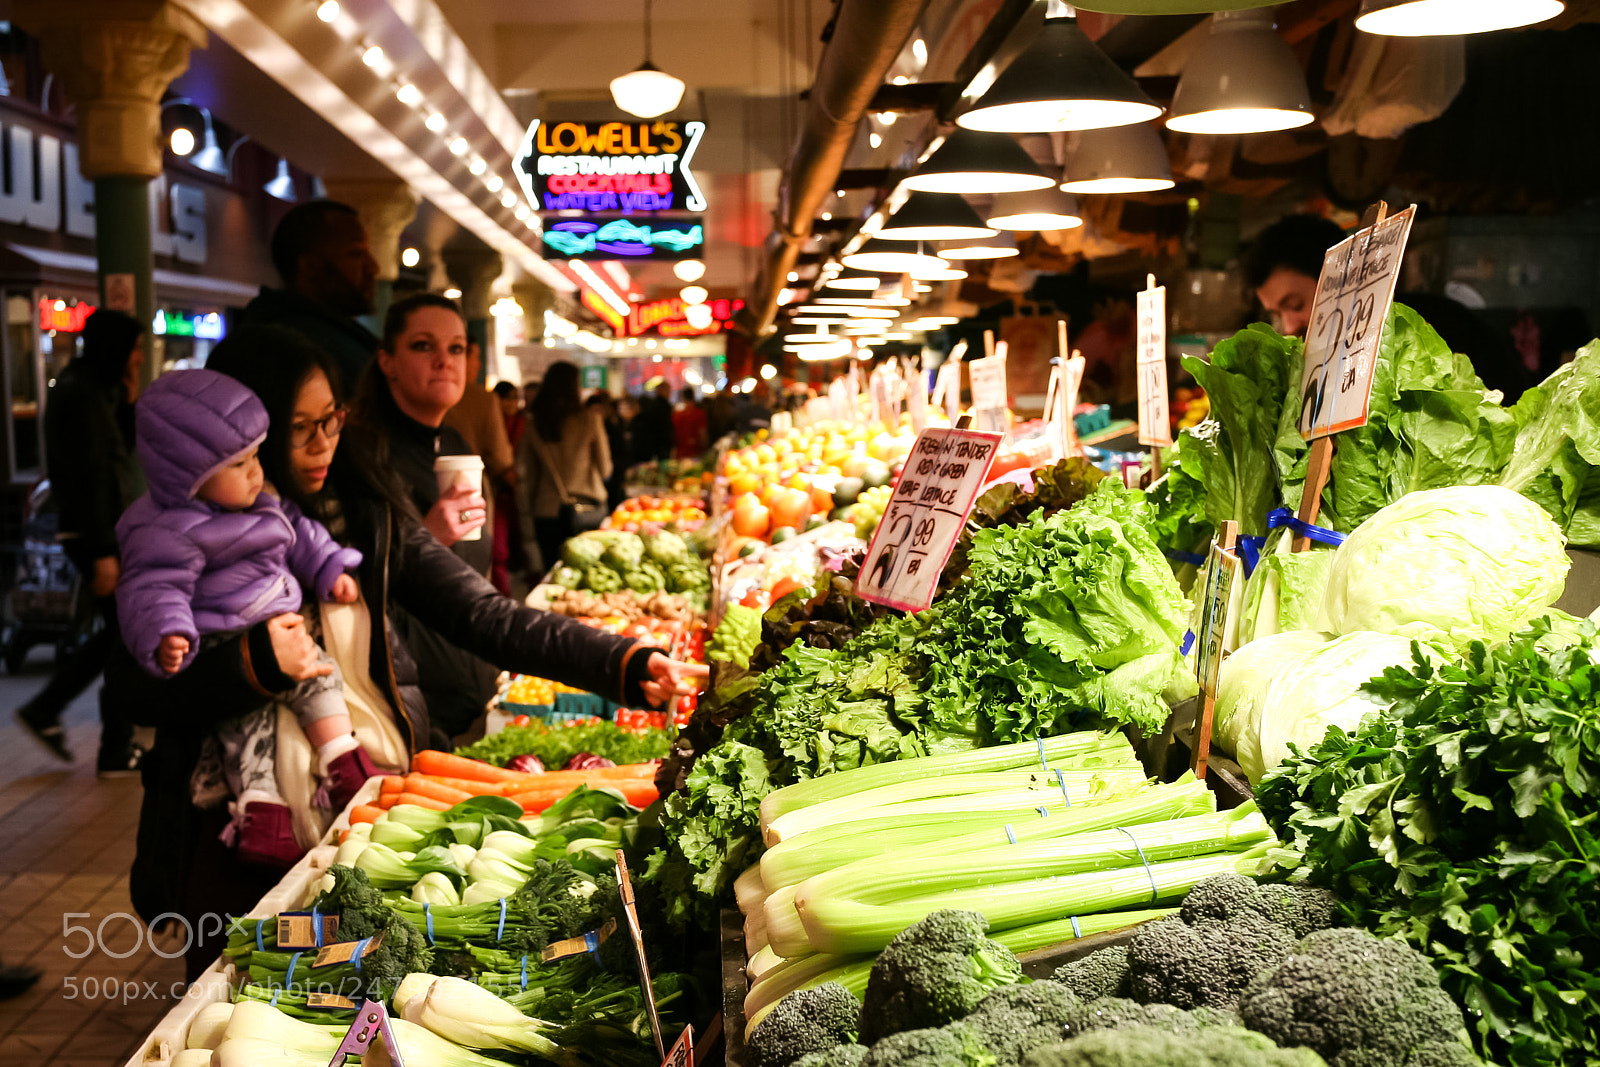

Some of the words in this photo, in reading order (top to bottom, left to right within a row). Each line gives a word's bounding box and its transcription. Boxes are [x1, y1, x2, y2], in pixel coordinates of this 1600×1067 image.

[537, 121, 682, 154] LOWELL'S
[537, 154, 679, 175] RESTAURANT
[547, 173, 672, 195] COCKTAILS
[543, 191, 618, 211] WATER
[619, 191, 674, 215] VIEW
[955, 442, 991, 461] TENDER
[939, 463, 969, 480] GREEN
[899, 480, 920, 497] LEAF
[913, 518, 936, 547] 99
